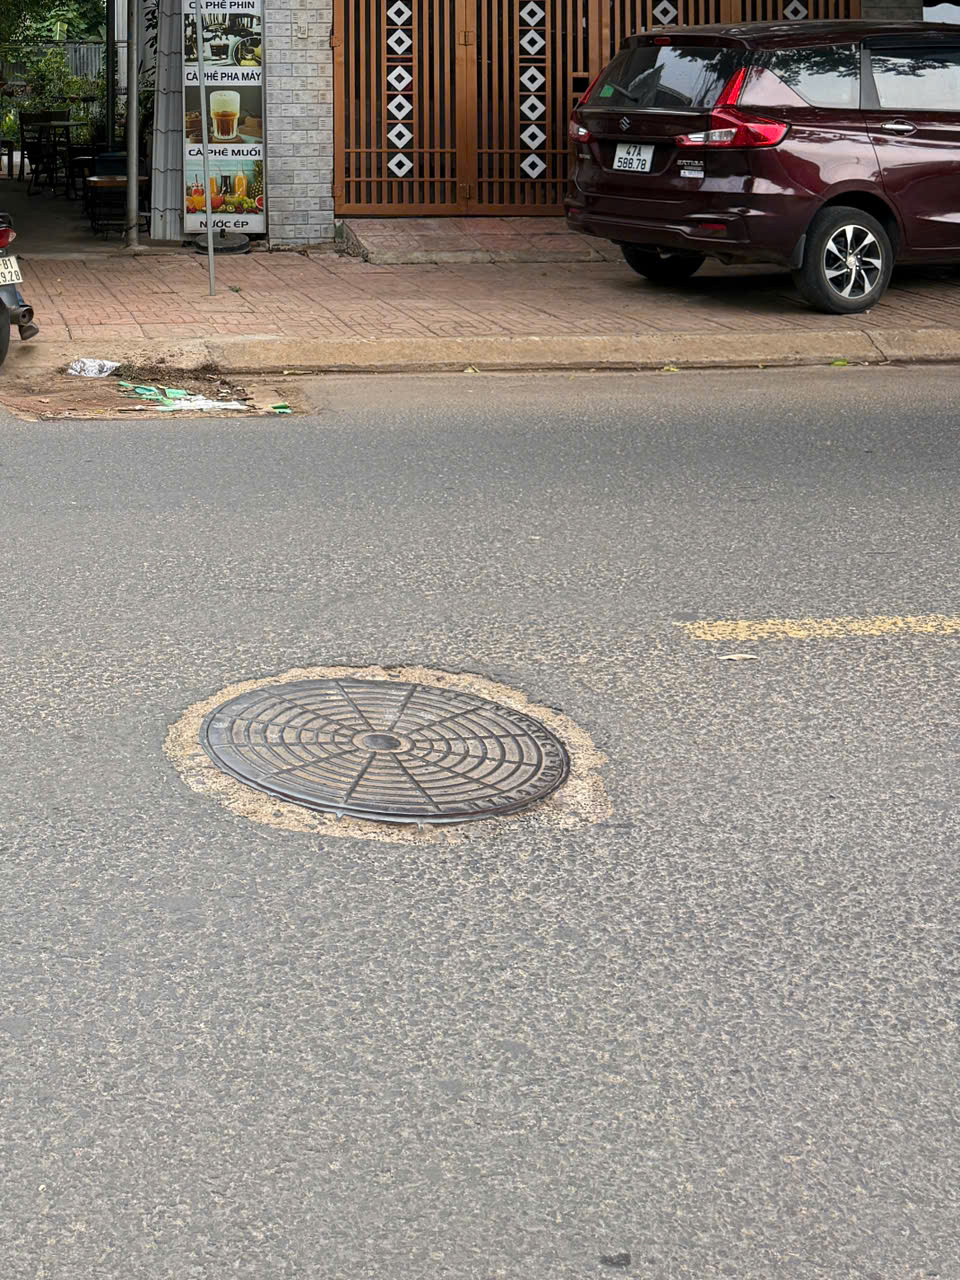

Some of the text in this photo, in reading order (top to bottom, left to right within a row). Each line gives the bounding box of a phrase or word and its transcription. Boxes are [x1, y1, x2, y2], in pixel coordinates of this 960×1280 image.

[205, 0, 227, 9] PHÊ
[229, 1, 255, 9] PHIN
[186, 70, 199, 81] CÀ
[221, 72, 240, 81] PHA
[241, 70, 261, 81] MÁY
[231, 146, 261, 157] MUỐI
[626, 145, 642, 157] 47A
[616, 157, 647, 170] 588.78
[234, 219, 248, 228] ÉP
